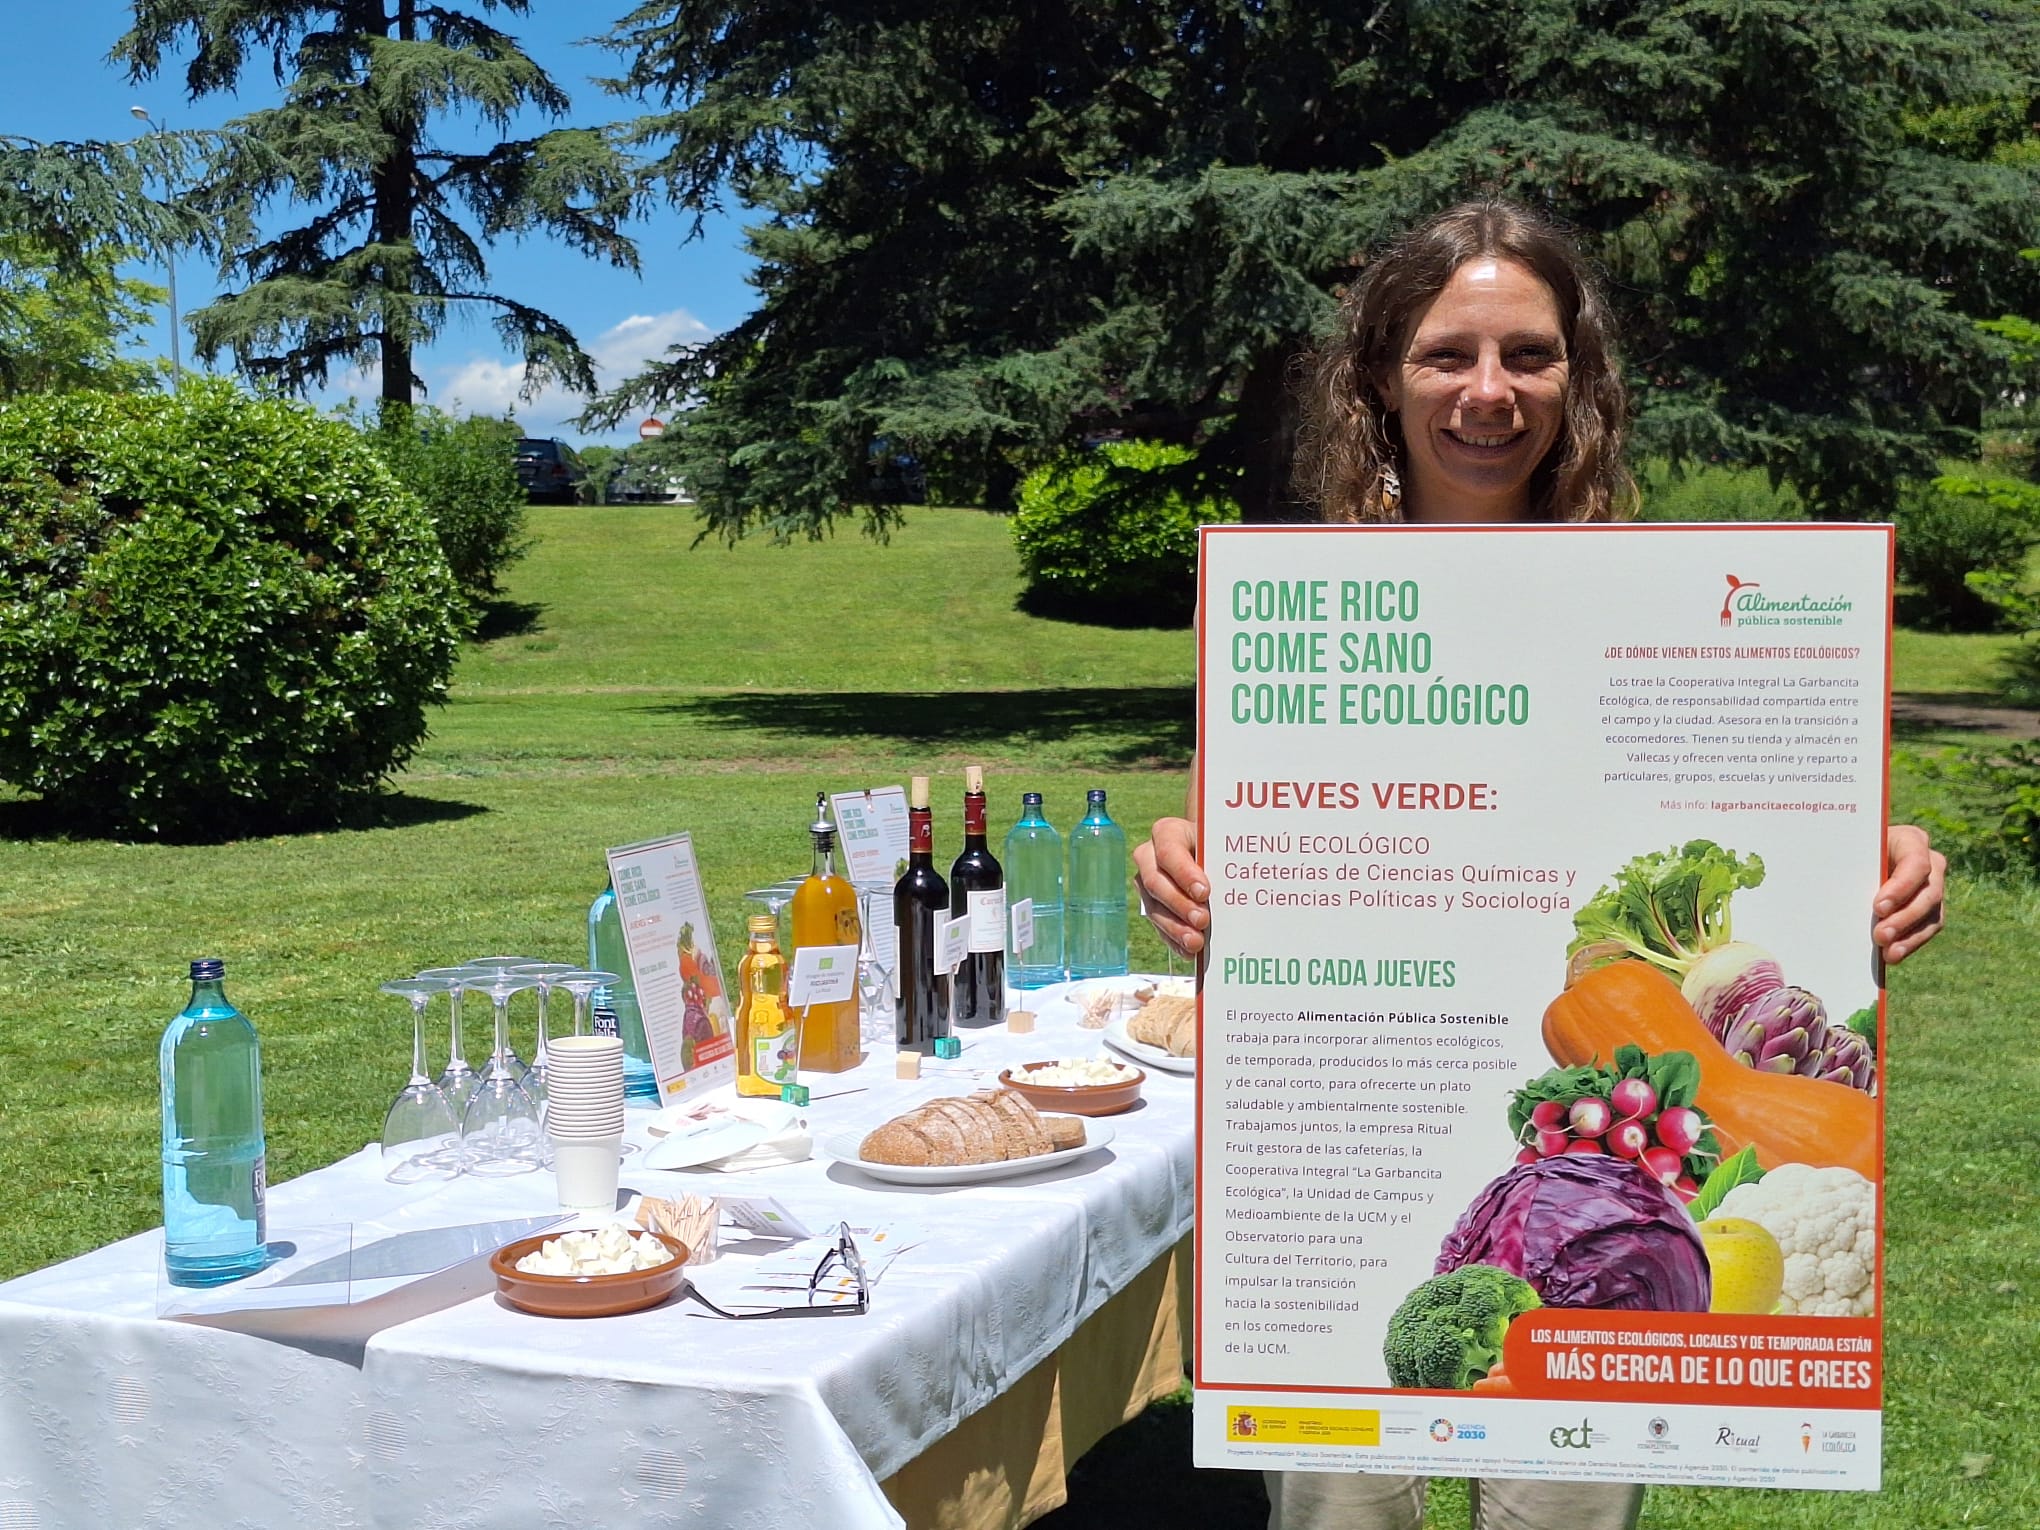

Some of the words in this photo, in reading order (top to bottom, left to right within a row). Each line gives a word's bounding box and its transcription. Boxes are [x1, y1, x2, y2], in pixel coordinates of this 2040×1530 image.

[1232, 580, 1328, 621] COME
[1341, 580, 1418, 621] RICO
[1737, 592, 1851, 611] Alimentación
[1738, 615, 1780, 627] pública
[1783, 615, 1842, 625] sostenible
[1232, 632, 1327, 672] COME
[1339, 632, 1431, 673] SANO
[1604, 647, 1622, 658] ¿DE
[1626, 645, 1658, 658] DÓNDE
[1662, 646, 1697, 658] VIENEN
[1701, 646, 1731, 658] ESTOS
[1734, 647, 1790, 658] ALIMENTOS
[1794, 645, 1859, 658] ECOLÓGICOS?
[1610, 677, 1628, 686] Los
[1631, 678, 1652, 687] trae
[1656, 676, 1665, 686] la
[1668, 677, 1734, 688] Cooperativa
[1738, 676, 1779, 689] Integral
[1783, 677, 1795, 686] La
[1798, 677, 1858, 687] Garbancita
[1232, 683, 1326, 724] COME
[1340, 676, 1528, 725] ECOLÓGICO
[1599, 695, 1651, 708] Ecológica,
[1655, 696, 1669, 705] de
[1672, 695, 1759, 708] responsabilidad
[1762, 696, 1825, 708] compartida
[1829, 697, 1858, 706] entre
[1605, 733, 1688, 743] ecocomedores.
[1691, 734, 1728, 743] Tienen
[1732, 736, 1744, 744] su
[1748, 733, 1782, 744] tienda
[1785, 737, 1791, 746] y
[1794, 734, 1840, 744] almacén
[1844, 736, 1857, 744] en
[1604, 771, 1671, 783] particulares,
[1674, 773, 1715, 784] grupos,
[1718, 772, 1765, 781] escuelas
[1768, 774, 1774, 784] y
[1777, 772, 1856, 782] universidades.
[1225, 781, 1359, 809] JUEVES
[1371, 782, 1496, 810] VERDE:
[1660, 800, 1681, 809] Más
[1711, 800, 1856, 813] lagarbancitaecologica.org
[1226, 832, 1290, 852] MENÚ
[1300, 831, 1429, 854] ECOLÓGICO
[1225, 861, 1327, 880] Cafeterías
[1336, 863, 1359, 880] de
[1367, 864, 1453, 881] Ciencias
[1462, 864, 1557, 884] Químicas
[1566, 870, 1576, 886] y
[1224, 888, 1247, 905] de
[1255, 889, 1340, 906] Ciencias
[1349, 889, 1436, 907] Políticas
[1444, 895, 1454, 912] y
[1462, 890, 1569, 913] Sociología
[1224, 952, 1300, 985] PÍDELO
[1308, 958, 1367, 986] CADA
[1373, 959, 1455, 987] JUEVES
[1227, 1010, 1235, 1020] El
[1240, 1012, 1293, 1023] proyecto
[1297, 1010, 1383, 1022] Alimentación
[1389, 1012, 1435, 1023] Pública
[1440, 1013, 1508, 1024] Sostenible
[1226, 1032, 1268, 1045] trabaja
[1273, 1035, 1299, 1046] para
[1304, 1033, 1368, 1047] incorporar
[1372, 1034, 1432, 1046] alimentos
[1436, 1035, 1503, 1050] ecológicos,
[1226, 1054, 1240, 1064] de
[1245, 1054, 1314, 1068] temporada,
[1319, 1055, 1388, 1069] producidos
[1392, 1056, 1402, 1067] lo
[1407, 1056, 1432, 1068] más
[1436, 1060, 1468, 1069] cerca
[1472, 1058, 1516, 1072] posible
[1226, 1098, 1283, 1110] saludable
[1287, 1102, 1294, 1113] y
[1297, 1099, 1398, 1112] ambientalmente
[1402, 1102, 1467, 1113] sostenible.
[1225, 1119, 1296, 1133] Trabajamos
[1300, 1120, 1341, 1135] juntos,
[1346, 1121, 1355, 1132] la
[1360, 1124, 1412, 1136] empresa
[1418, 1123, 1451, 1134] Ritual
[1226, 1164, 1298, 1178] Cooperativa
[1302, 1165, 1348, 1179] Integral
[1374, 1167, 1441, 1179] Garbancita
[1293, 1187, 1302, 1198] la
[1307, 1188, 1350, 1199] Unidad
[1354, 1188, 1369, 1199] de
[1373, 1189, 1423, 1203] Campus
[1427, 1193, 1433, 1204] y
[1226, 1208, 1320, 1221] Medioambiente
[1324, 1210, 1339, 1221] de
[1344, 1210, 1353, 1221] la
[1358, 1211, 1386, 1222] UCM
[1390, 1214, 1397, 1225] y
[1401, 1212, 1410, 1223] el
[1225, 1230, 1304, 1242] Observatorio
[1308, 1235, 1335, 1246] para
[1340, 1236, 1362, 1244] una
[1225, 1252, 1269, 1264] Cultura
[1273, 1253, 1290, 1264] del
[1294, 1254, 1355, 1267] Territorio,
[1360, 1258, 1386, 1270] para
[1225, 1275, 1278, 1288] impulsar
[1282, 1276, 1291, 1287] la
[1296, 1277, 1355, 1288] transición
[1225, 1296, 1256, 1308] hacia
[1260, 1297, 1270, 1309] la
[1274, 1298, 1358, 1311] sostenibilidad
[1225, 1322, 1239, 1330] en
[1244, 1320, 1260, 1331] los
[1264, 1320, 1332, 1333] comedores
[1225, 1342, 1239, 1352] de
[1244, 1342, 1253, 1353] la
[1258, 1343, 1290, 1354] UCM.
[1531, 1329, 1551, 1342] LOS
[1553, 1329, 1615, 1344] ALIMENTOS
[1618, 1330, 1686, 1347] ECOLÓGICOS,
[1689, 1334, 1737, 1348] LOCALES
[1740, 1335, 1747, 1348] Y
[1750, 1335, 1764, 1349] DE
[1766, 1336, 1834, 1351] TEMPORADA
[1837, 1335, 1871, 1352] ESTÁN
[1546, 1348, 1595, 1380] MÁS
[1601, 1353, 1674, 1382] CERCA
[1681, 1356, 1709, 1384] DE
[1716, 1357, 1743, 1385] LO
[1749, 1358, 1792, 1387] QUE
[1799, 1359, 1871, 1389] CREES
[1457, 1430, 1486, 1440] 2030
[1715, 1426, 1760, 1447] Ritual
